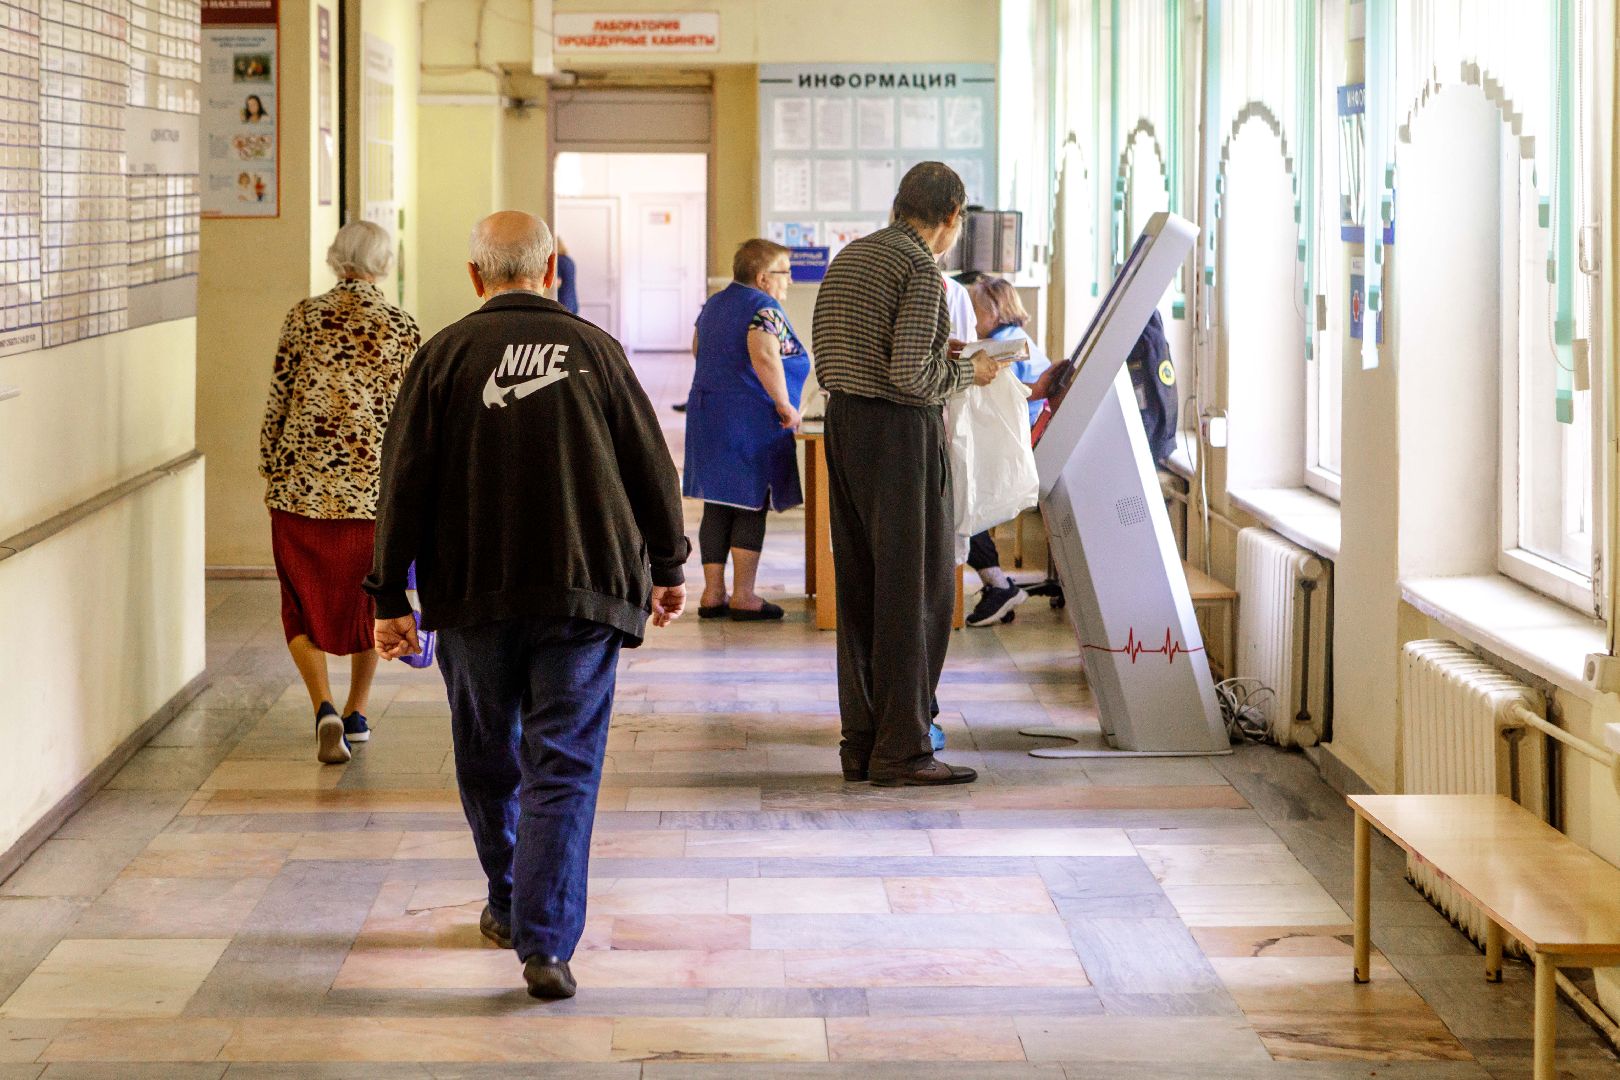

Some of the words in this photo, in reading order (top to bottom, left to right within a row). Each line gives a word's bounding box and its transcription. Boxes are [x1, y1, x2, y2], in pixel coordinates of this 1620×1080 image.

[593, 19, 681, 32] ЛАБОРАТОРИЯ
[558, 35, 647, 48] ПРОЦЕДУРНЫЕ
[651, 34, 715, 46] КАБИНЕТЫ
[798, 73, 957, 90] ИНФОРМАЦИЯ
[497, 344, 569, 377] NIKE
